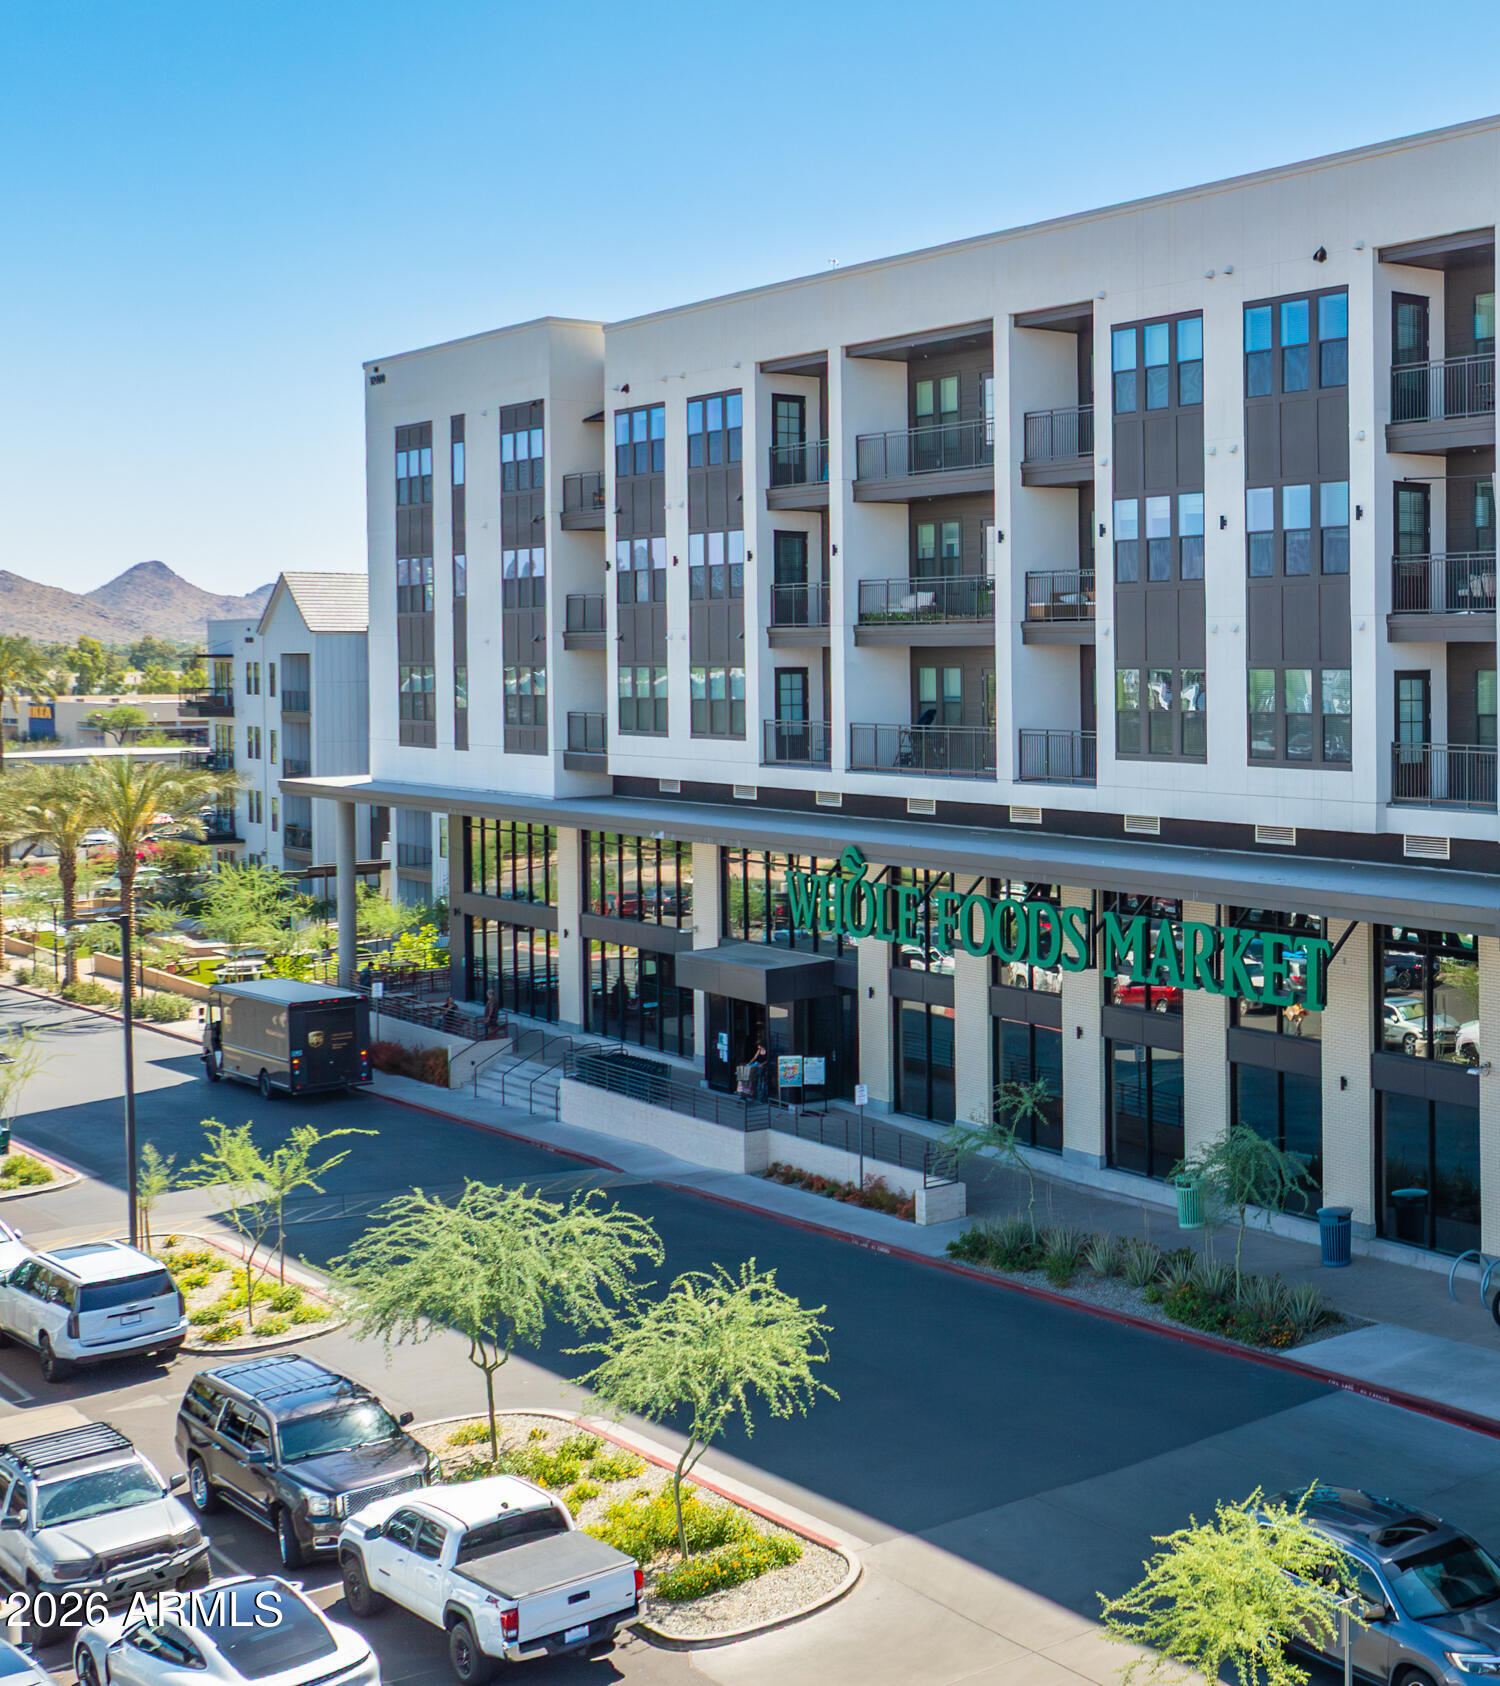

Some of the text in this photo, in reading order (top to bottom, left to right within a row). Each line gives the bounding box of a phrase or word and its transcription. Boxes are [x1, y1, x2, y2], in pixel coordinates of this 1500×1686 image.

[29, 705, 52, 719] IKEA
[784, 868, 1333, 1012] WHOLE FOODS MARKET
